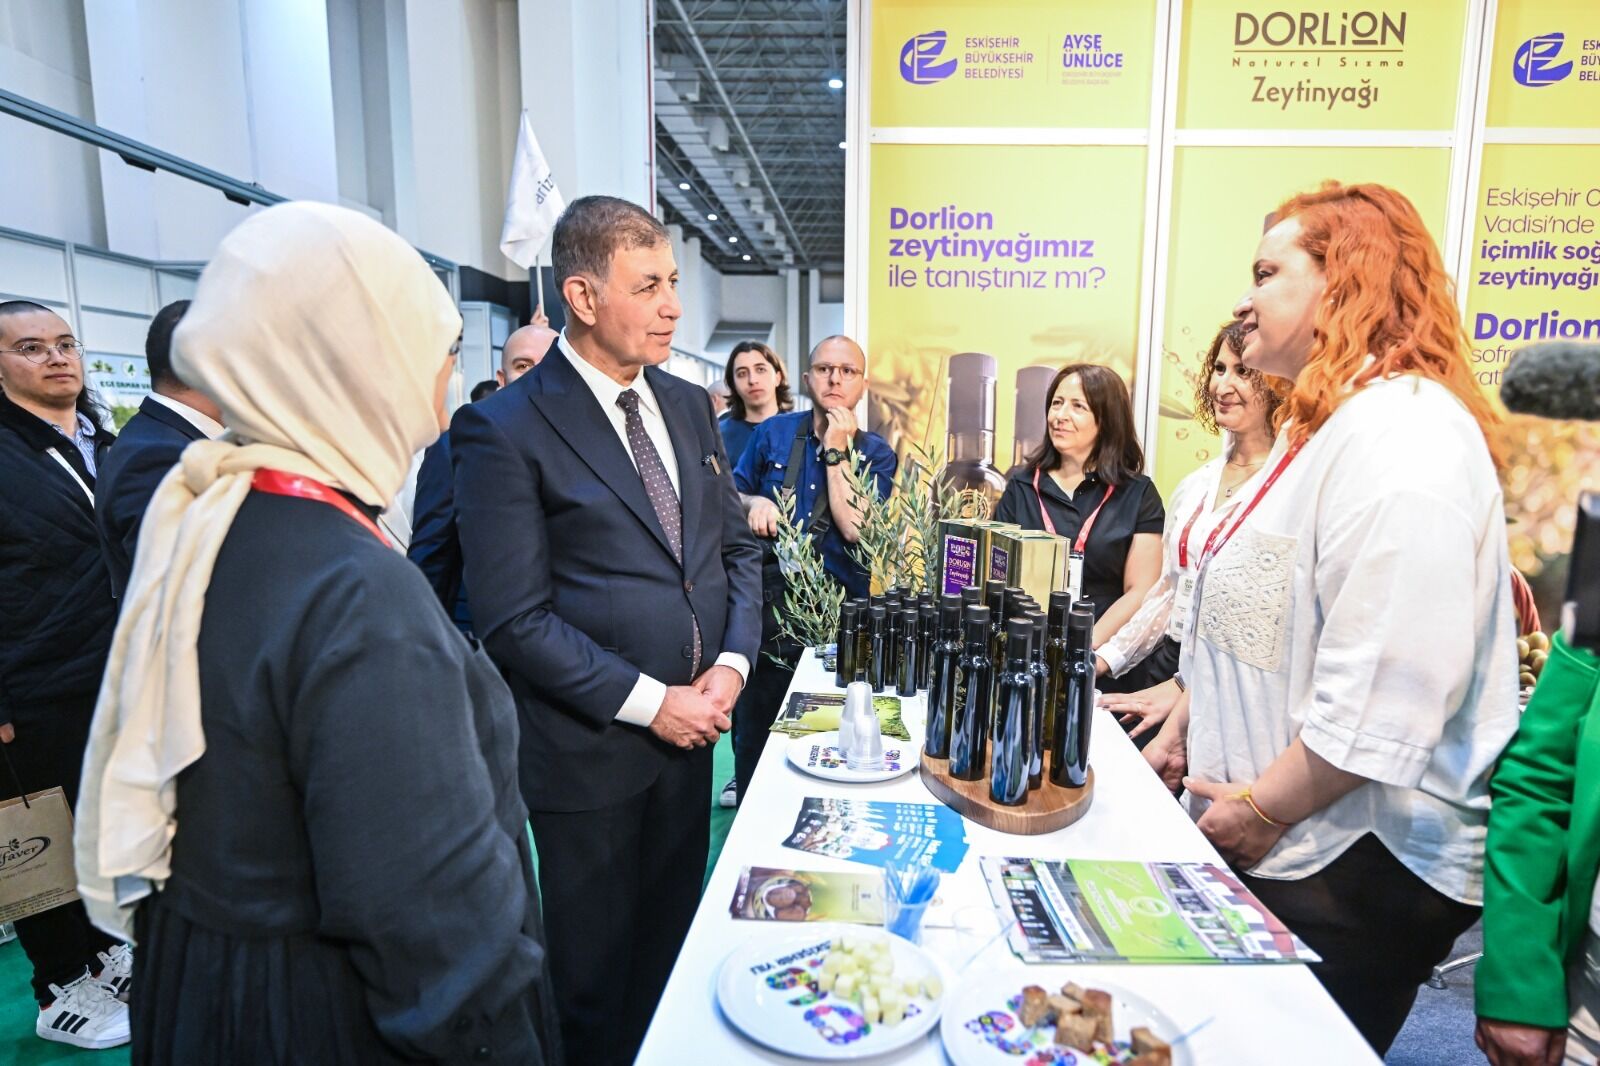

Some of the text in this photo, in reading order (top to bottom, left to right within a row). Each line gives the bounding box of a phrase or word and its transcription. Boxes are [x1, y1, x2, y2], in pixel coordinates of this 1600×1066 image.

[965, 35, 1020, 49] ESKİŞEHİR
[1063, 34, 1102, 51] AYŞE
[965, 51, 1034, 64] BÜYÜKŞEHİR
[1063, 49, 1123, 68] ÜNLÜCE
[1232, 57, 1404, 67] Naturel Sızma
[964, 66, 1024, 79] BELEDİYESİ
[1251, 76, 1379, 111] Zeytinyağı
[1486, 187, 1581, 209] Eskişehir
[890, 205, 993, 230] Dorlion
[889, 232, 1094, 263] zeytinyağımız
[1481, 240, 1558, 262] içimlik
[889, 264, 1106, 292] ile tanıştınız mı?
[1478, 266, 1599, 290] zeytinyağı
[1471, 345, 1512, 363] sofr
